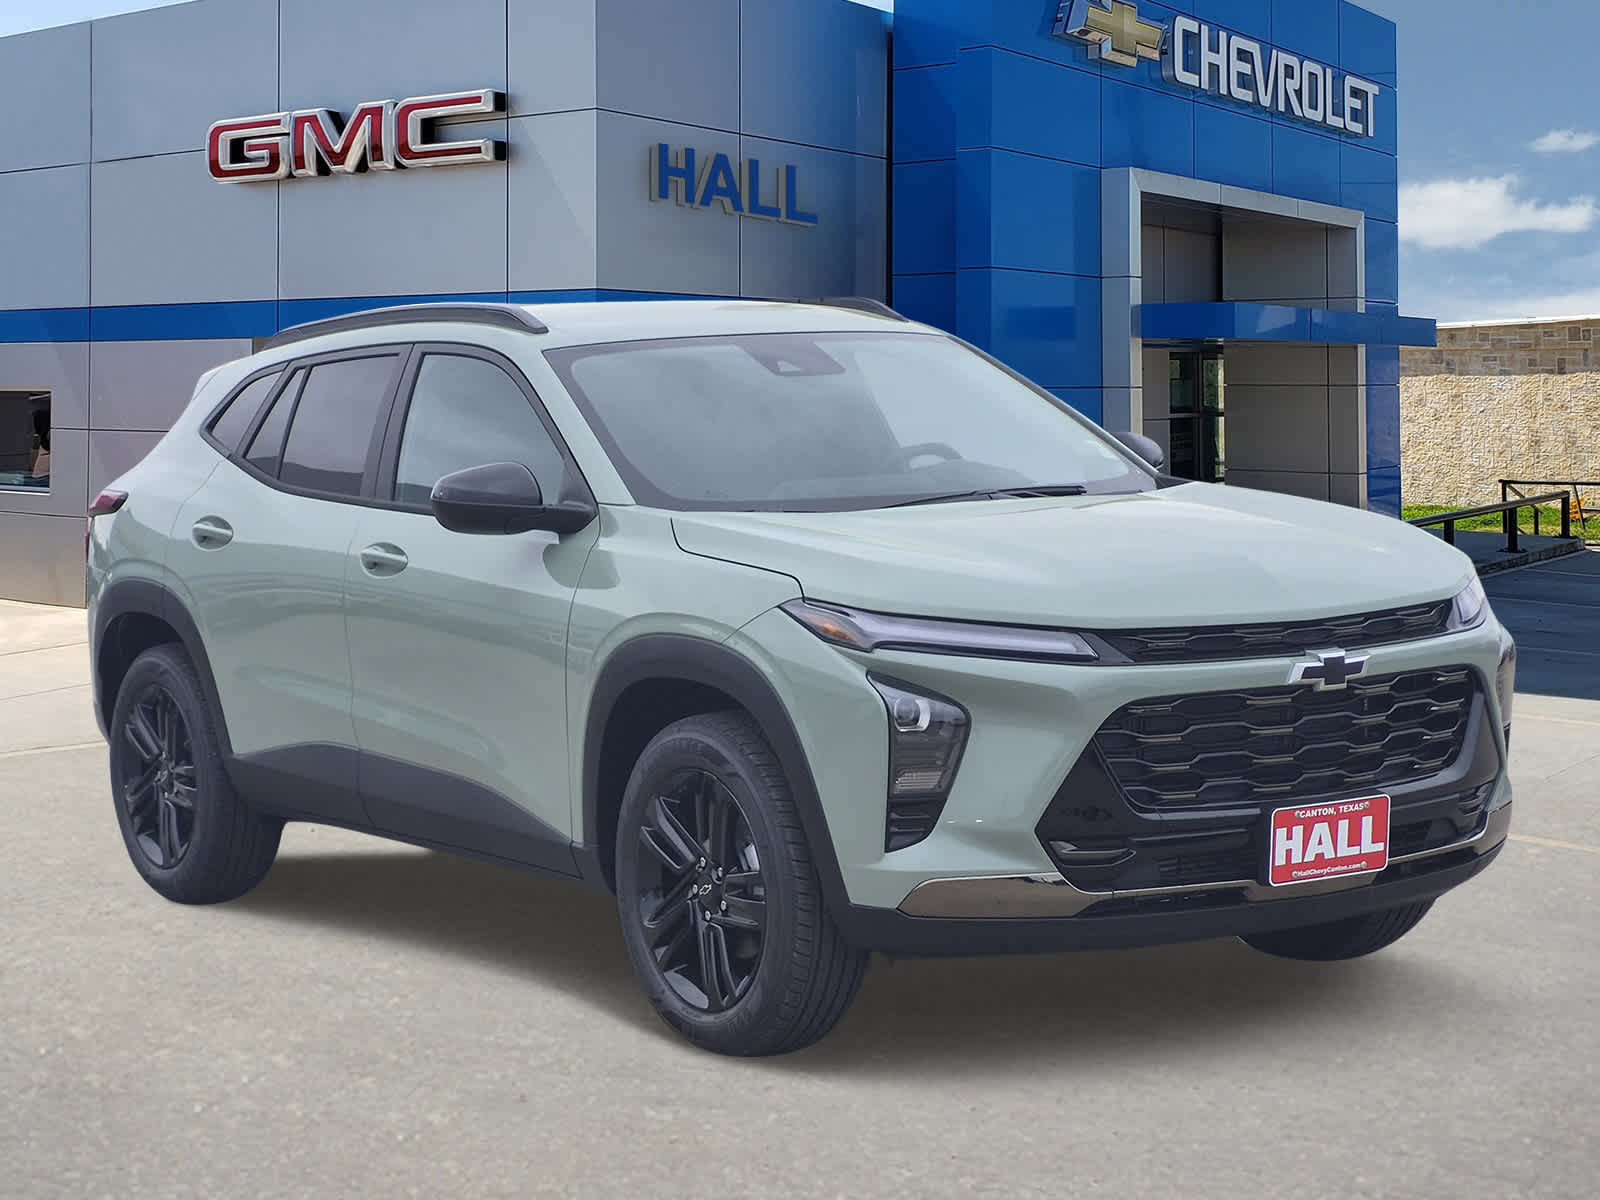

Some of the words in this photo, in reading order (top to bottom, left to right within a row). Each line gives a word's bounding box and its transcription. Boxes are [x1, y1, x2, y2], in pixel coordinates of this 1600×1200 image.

[1173, 15, 1380, 137] CHEVROLET
[206, 88, 507, 184] GMC
[650, 142, 819, 226] HALL
[1274, 815, 1385, 867] HALL
[1299, 807, 1337, 818] CANTON,
[1338, 803, 1364, 813] TEXAS
